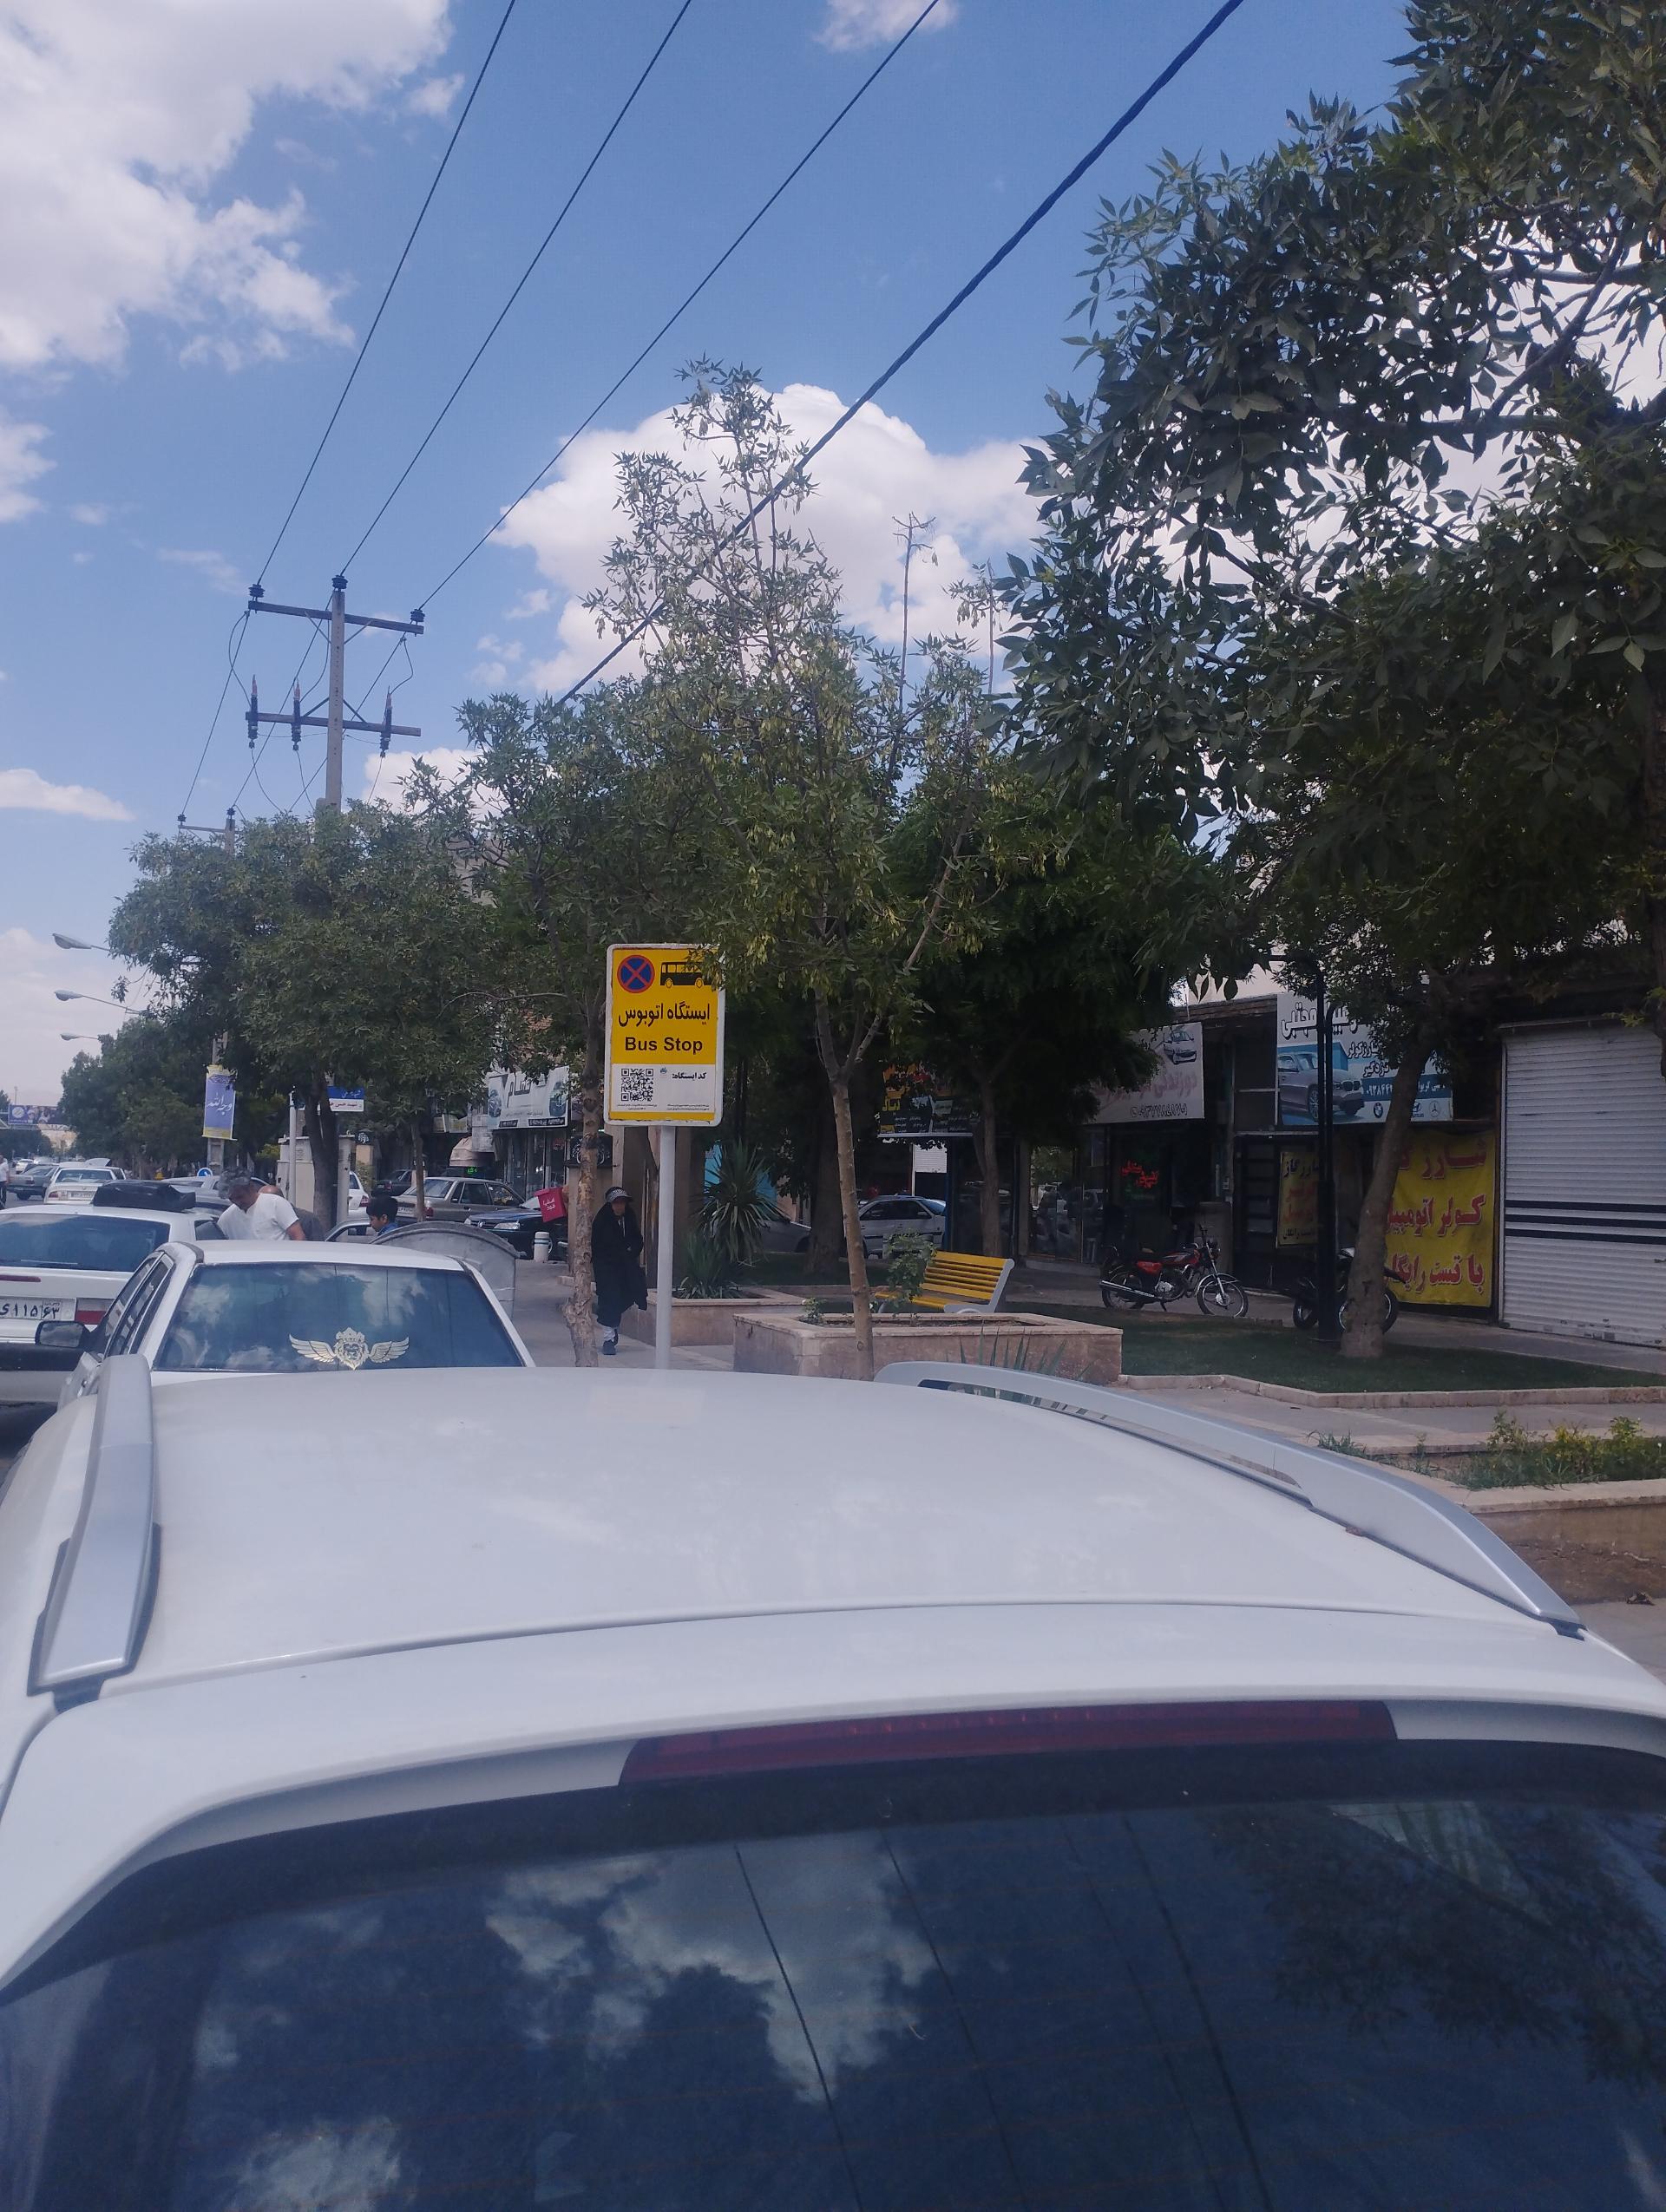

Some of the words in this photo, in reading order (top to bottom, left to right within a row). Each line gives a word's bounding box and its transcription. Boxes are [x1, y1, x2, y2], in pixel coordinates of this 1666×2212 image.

[619, 1002, 664, 1027] اتوبوس
[666, 1001, 710, 1025] ایستگاه
[625, 1037, 658, 1051] Bus
[663, 1036, 703, 1055] Stop
[1435, 1194, 1486, 1236] کولر
[1428, 1254, 1463, 1286] تست
[1466, 1253, 1486, 1294] با
